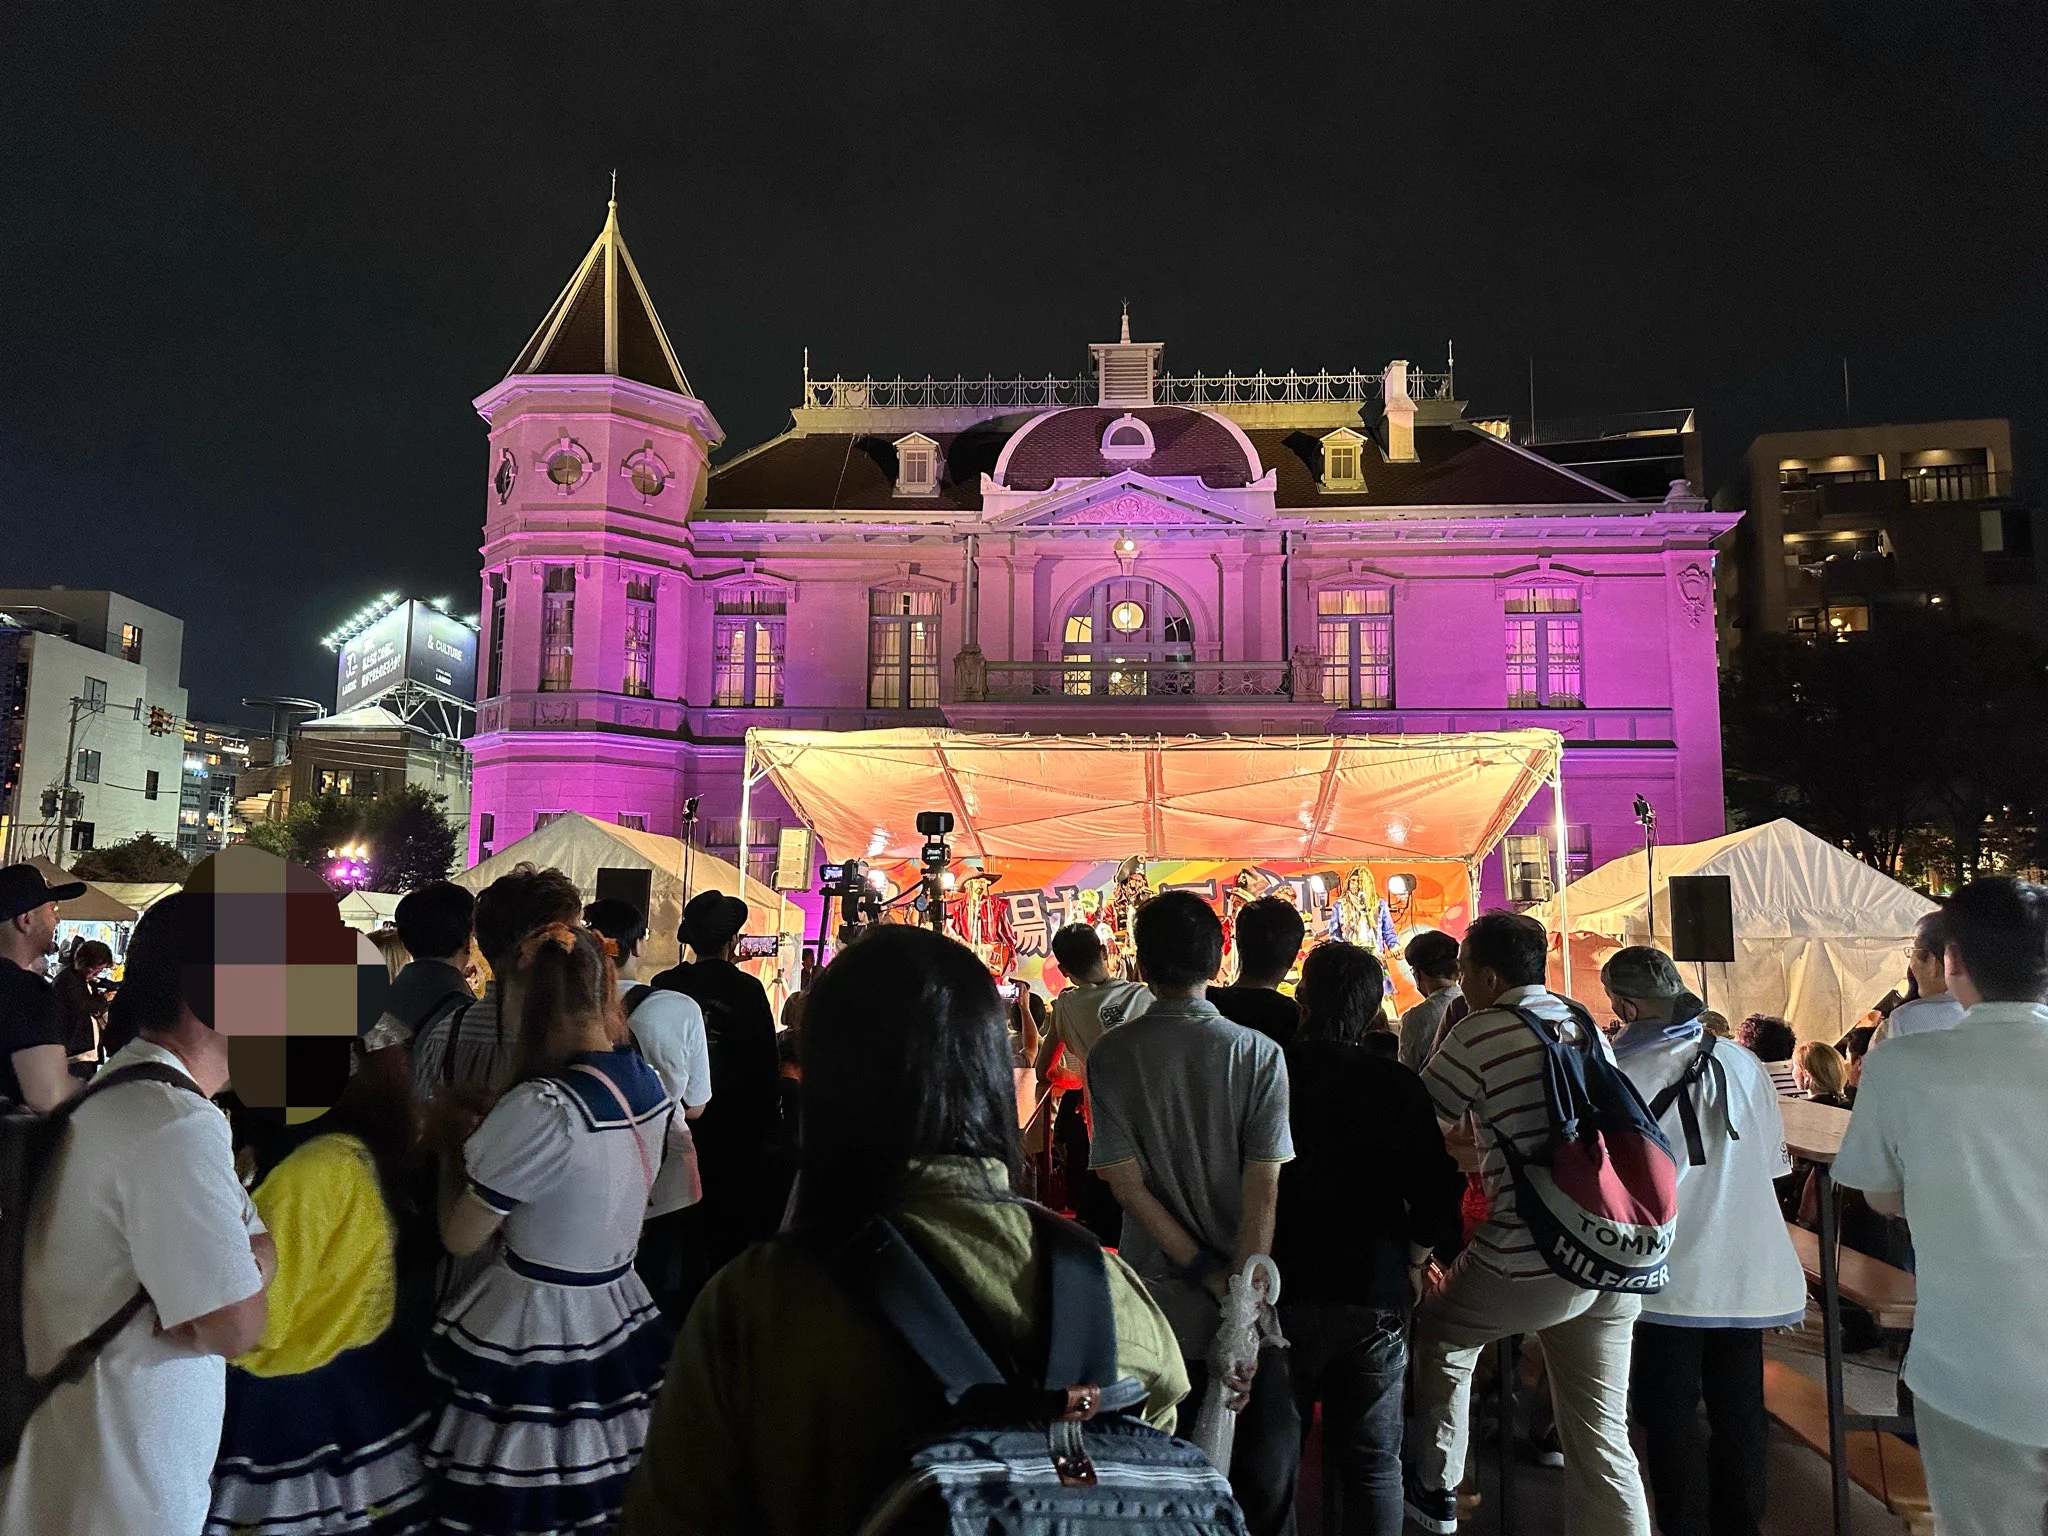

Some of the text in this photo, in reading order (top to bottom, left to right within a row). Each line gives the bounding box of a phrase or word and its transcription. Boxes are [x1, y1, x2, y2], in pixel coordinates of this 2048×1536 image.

[435, 639, 463, 662] CULTURE
[1578, 1213, 1675, 1255] TOMMY
[1552, 1235, 1671, 1288] HILFIGER
